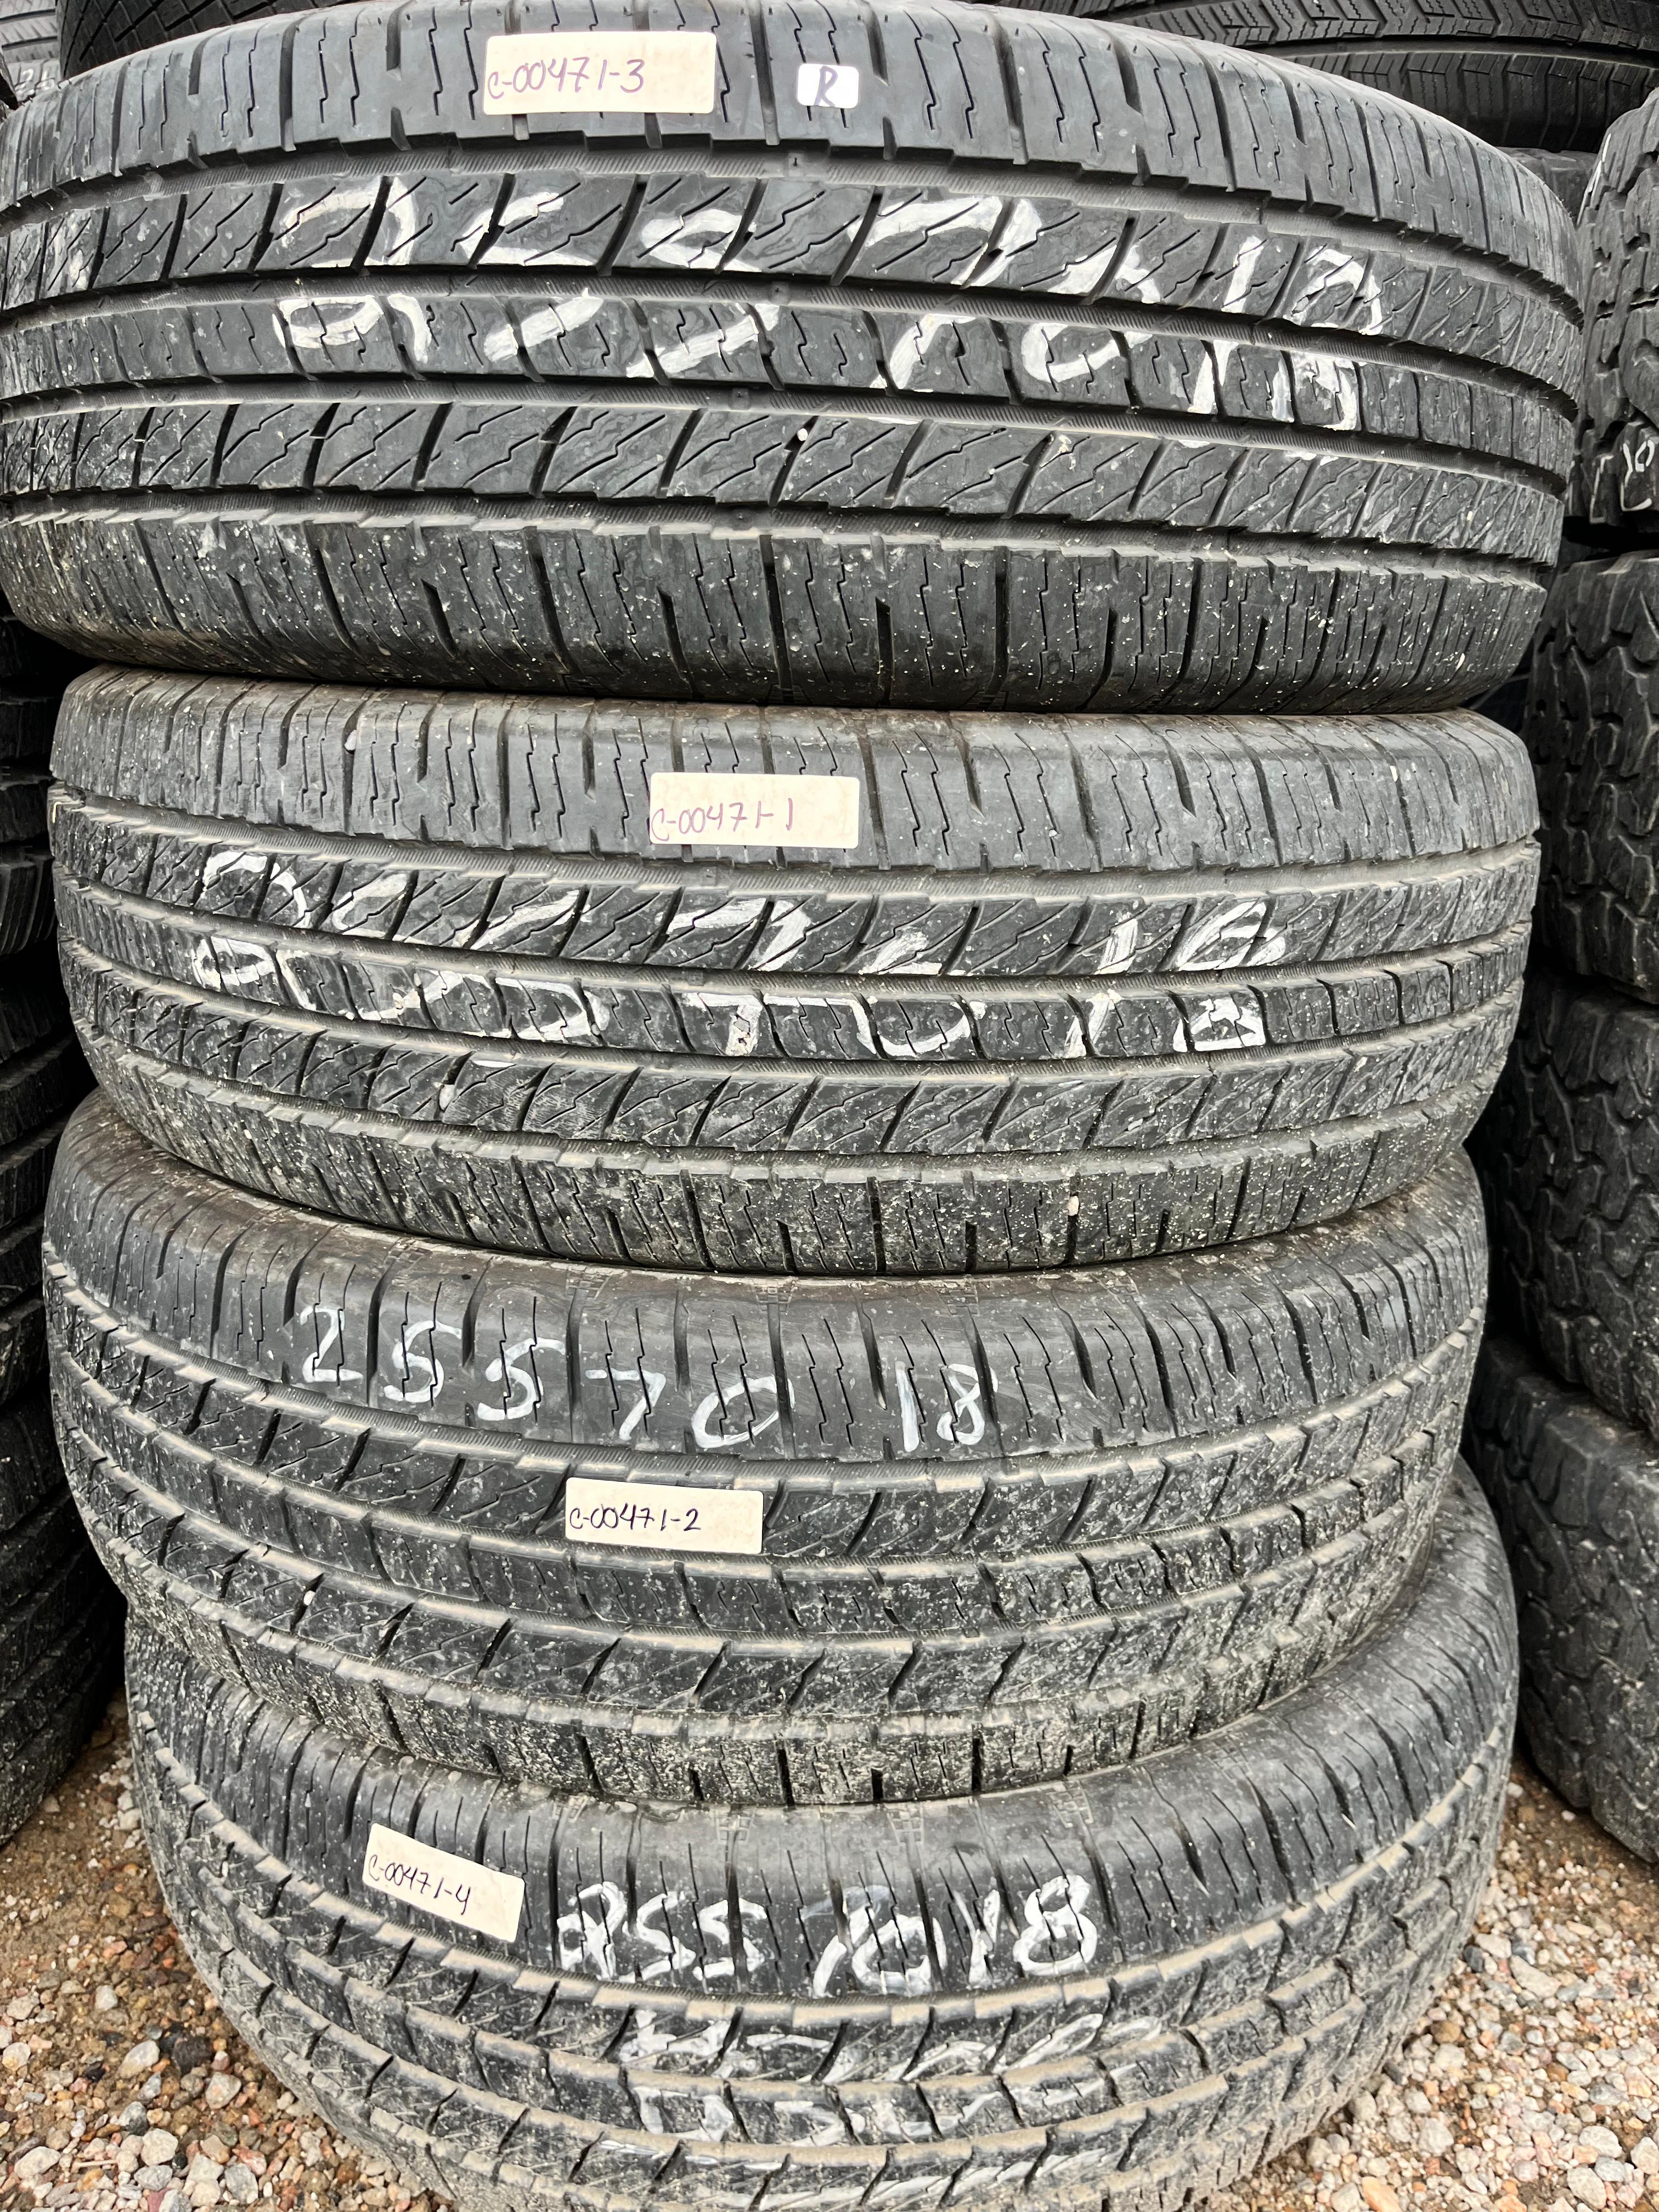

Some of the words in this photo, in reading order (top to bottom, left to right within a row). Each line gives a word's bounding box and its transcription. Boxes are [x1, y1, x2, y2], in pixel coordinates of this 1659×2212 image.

[815, 65, 836, 107] R
[300, 1303, 565, 1421] 255
[585, 1368, 795, 1449] 70
[893, 1360, 998, 1452] 18
